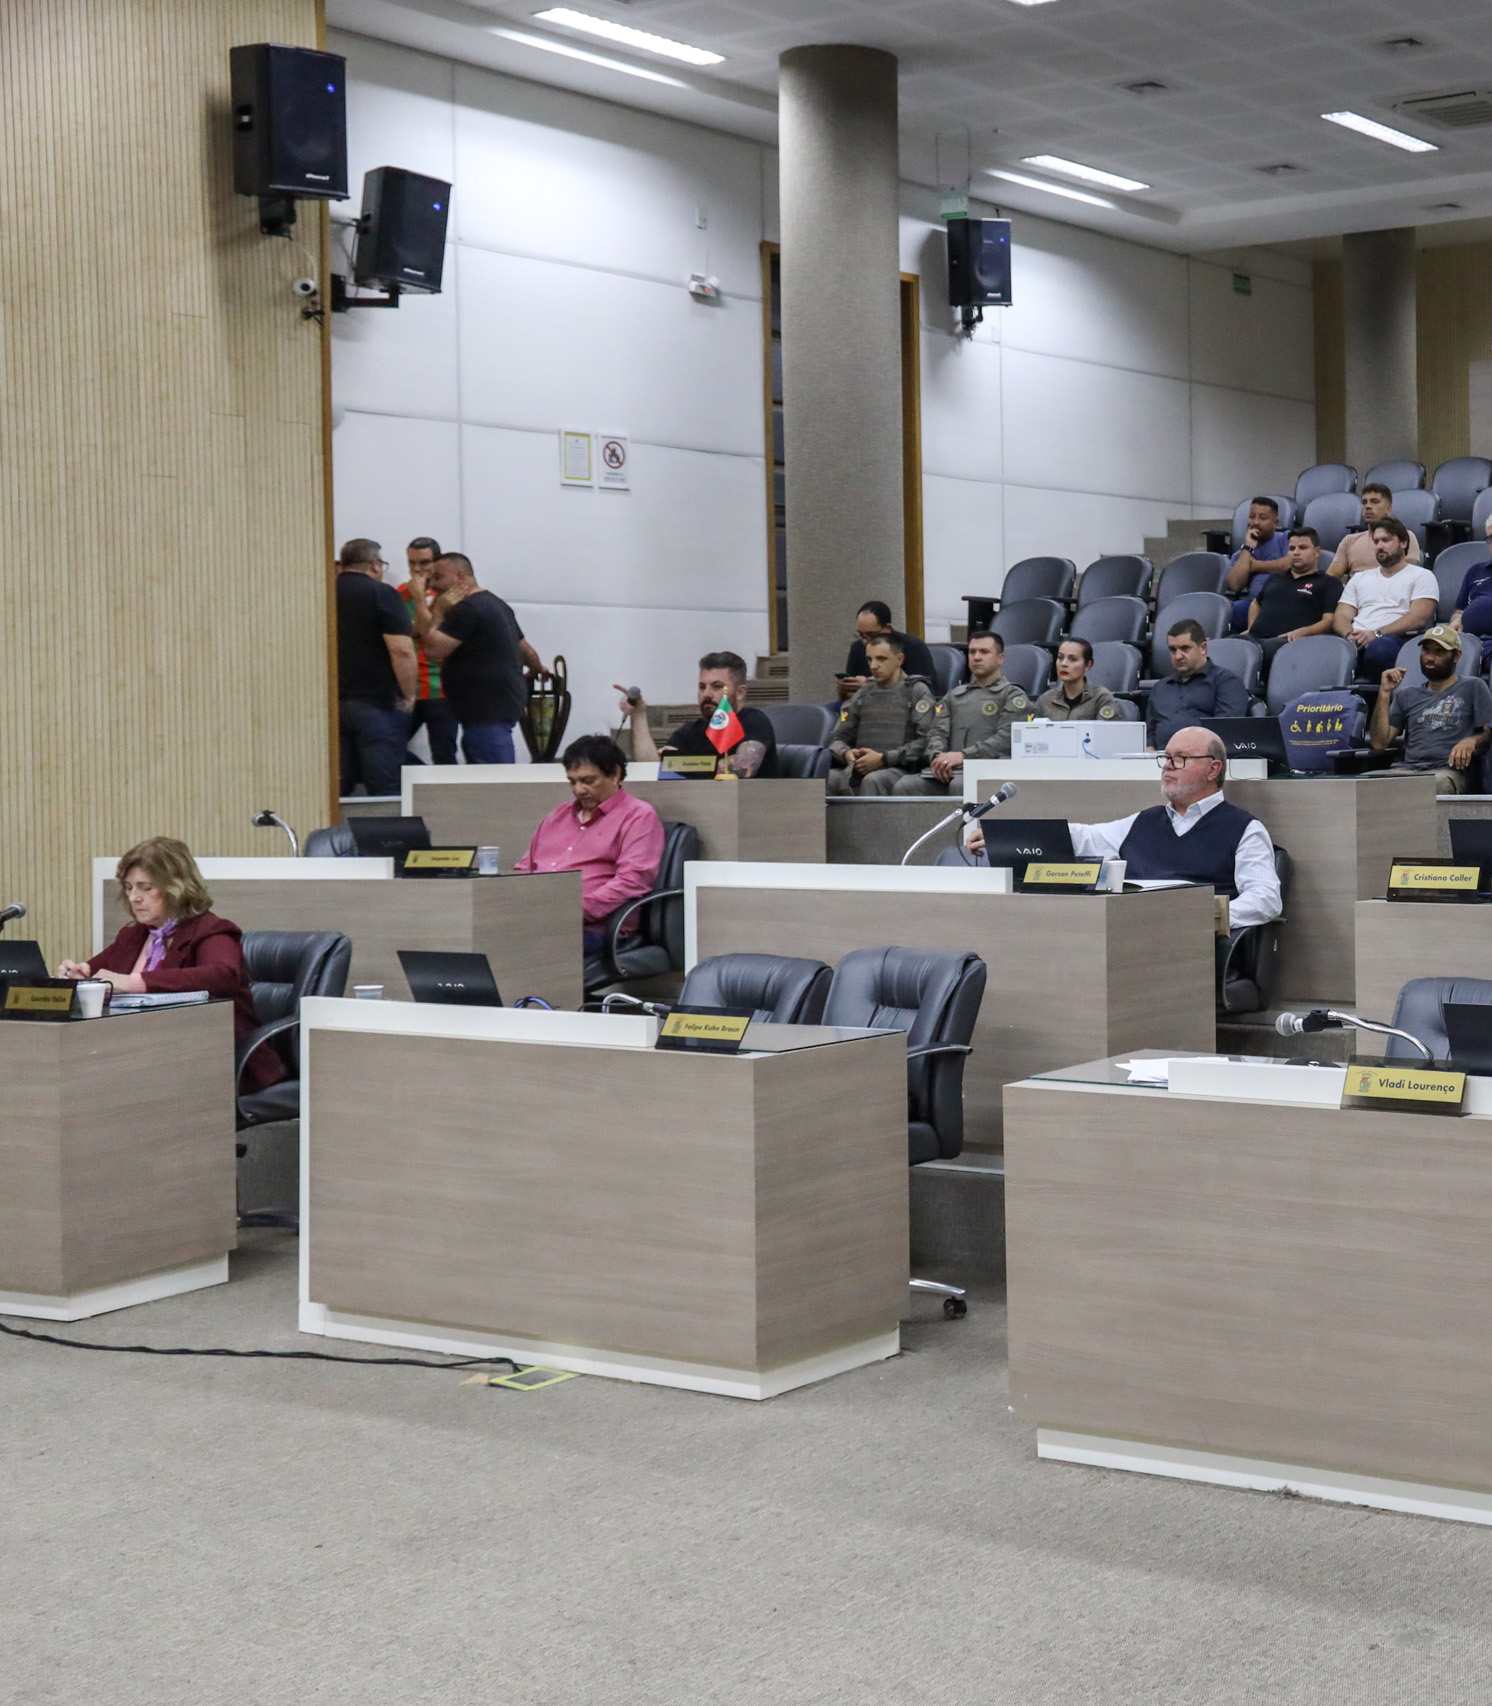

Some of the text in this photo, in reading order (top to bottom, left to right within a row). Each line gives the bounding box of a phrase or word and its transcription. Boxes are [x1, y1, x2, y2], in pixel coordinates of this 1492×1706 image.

[1296, 704, 1344, 713] Prioritário
[1233, 742, 1257, 750] VAIO
[1045, 870, 1092, 878] Gerson Peteffi
[1413, 873, 1473, 882] Cristiano Coller
[684, 1023, 703, 1031] Felipe
[1378, 1078, 1455, 1094] Vladi Lourenço
